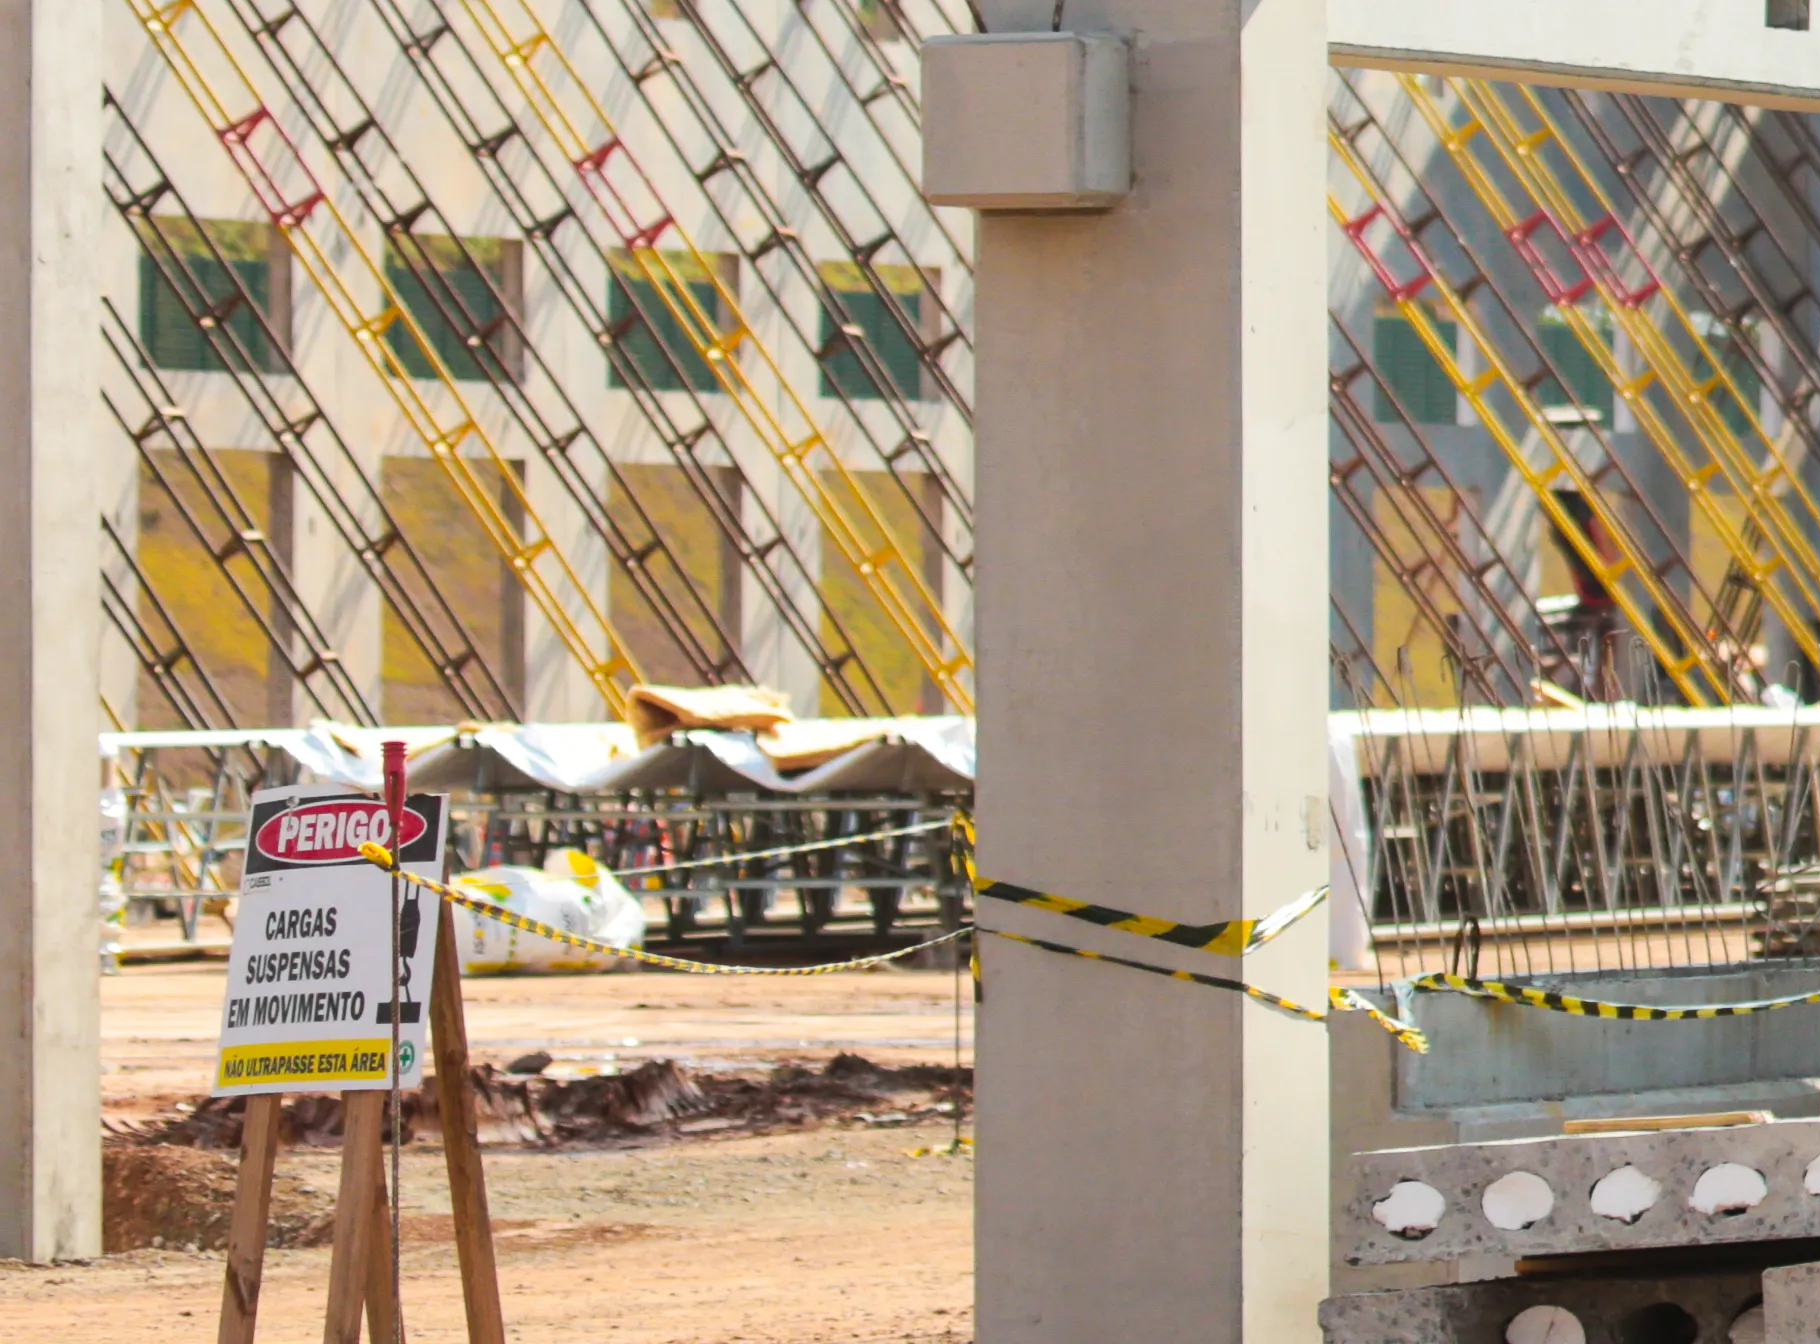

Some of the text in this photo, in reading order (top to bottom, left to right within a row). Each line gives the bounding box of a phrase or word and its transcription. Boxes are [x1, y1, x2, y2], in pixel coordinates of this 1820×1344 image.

[277, 809, 392, 853] PERIGO
[265, 907, 337, 940] CARGAS
[246, 948, 351, 985] SUSPENSAS
[227, 990, 365, 1028] EM MOVIMENTO
[223, 1047, 386, 1078] NÃO ULTRAPASSE ESTA ÁREA
